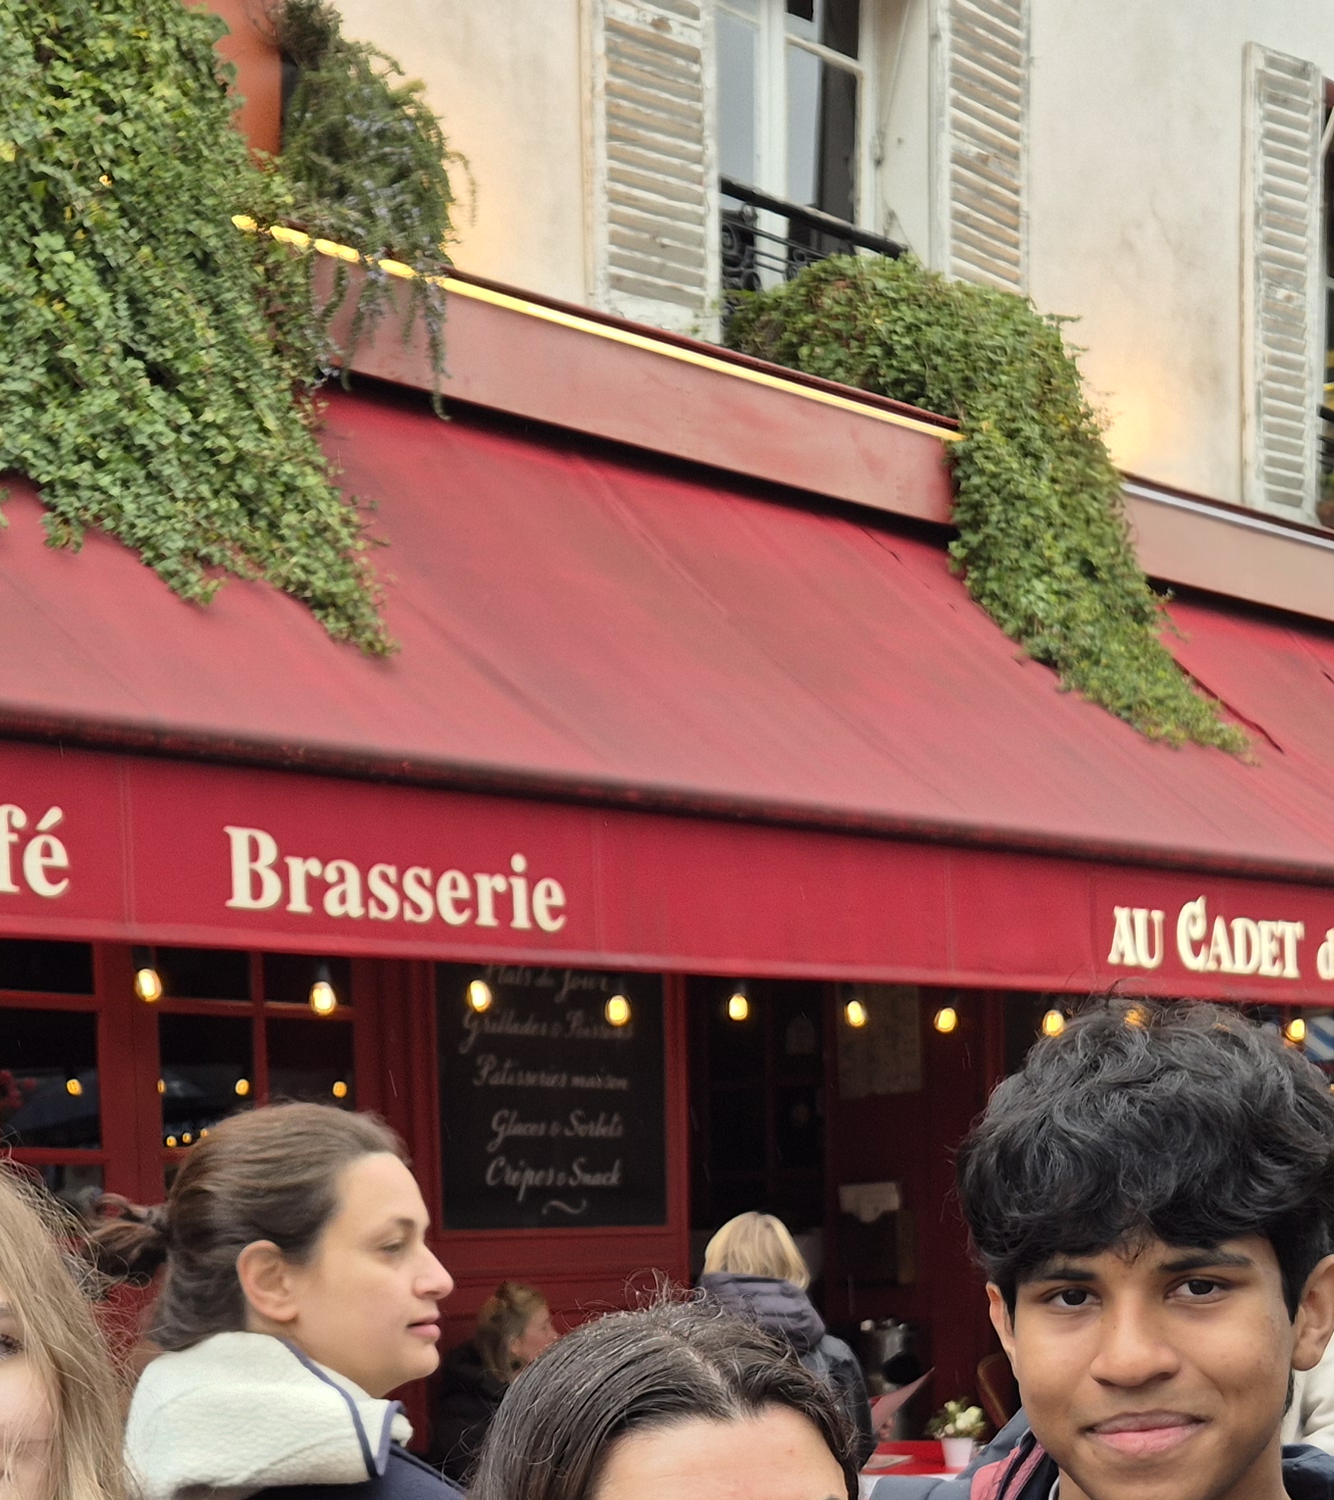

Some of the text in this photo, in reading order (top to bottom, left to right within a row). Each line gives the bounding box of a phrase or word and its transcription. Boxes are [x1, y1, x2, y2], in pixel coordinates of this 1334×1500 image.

[225, 827, 565, 932] Brasserie
[1108, 907, 1163, 968] AU
[1177, 896, 1304, 978] CADET
